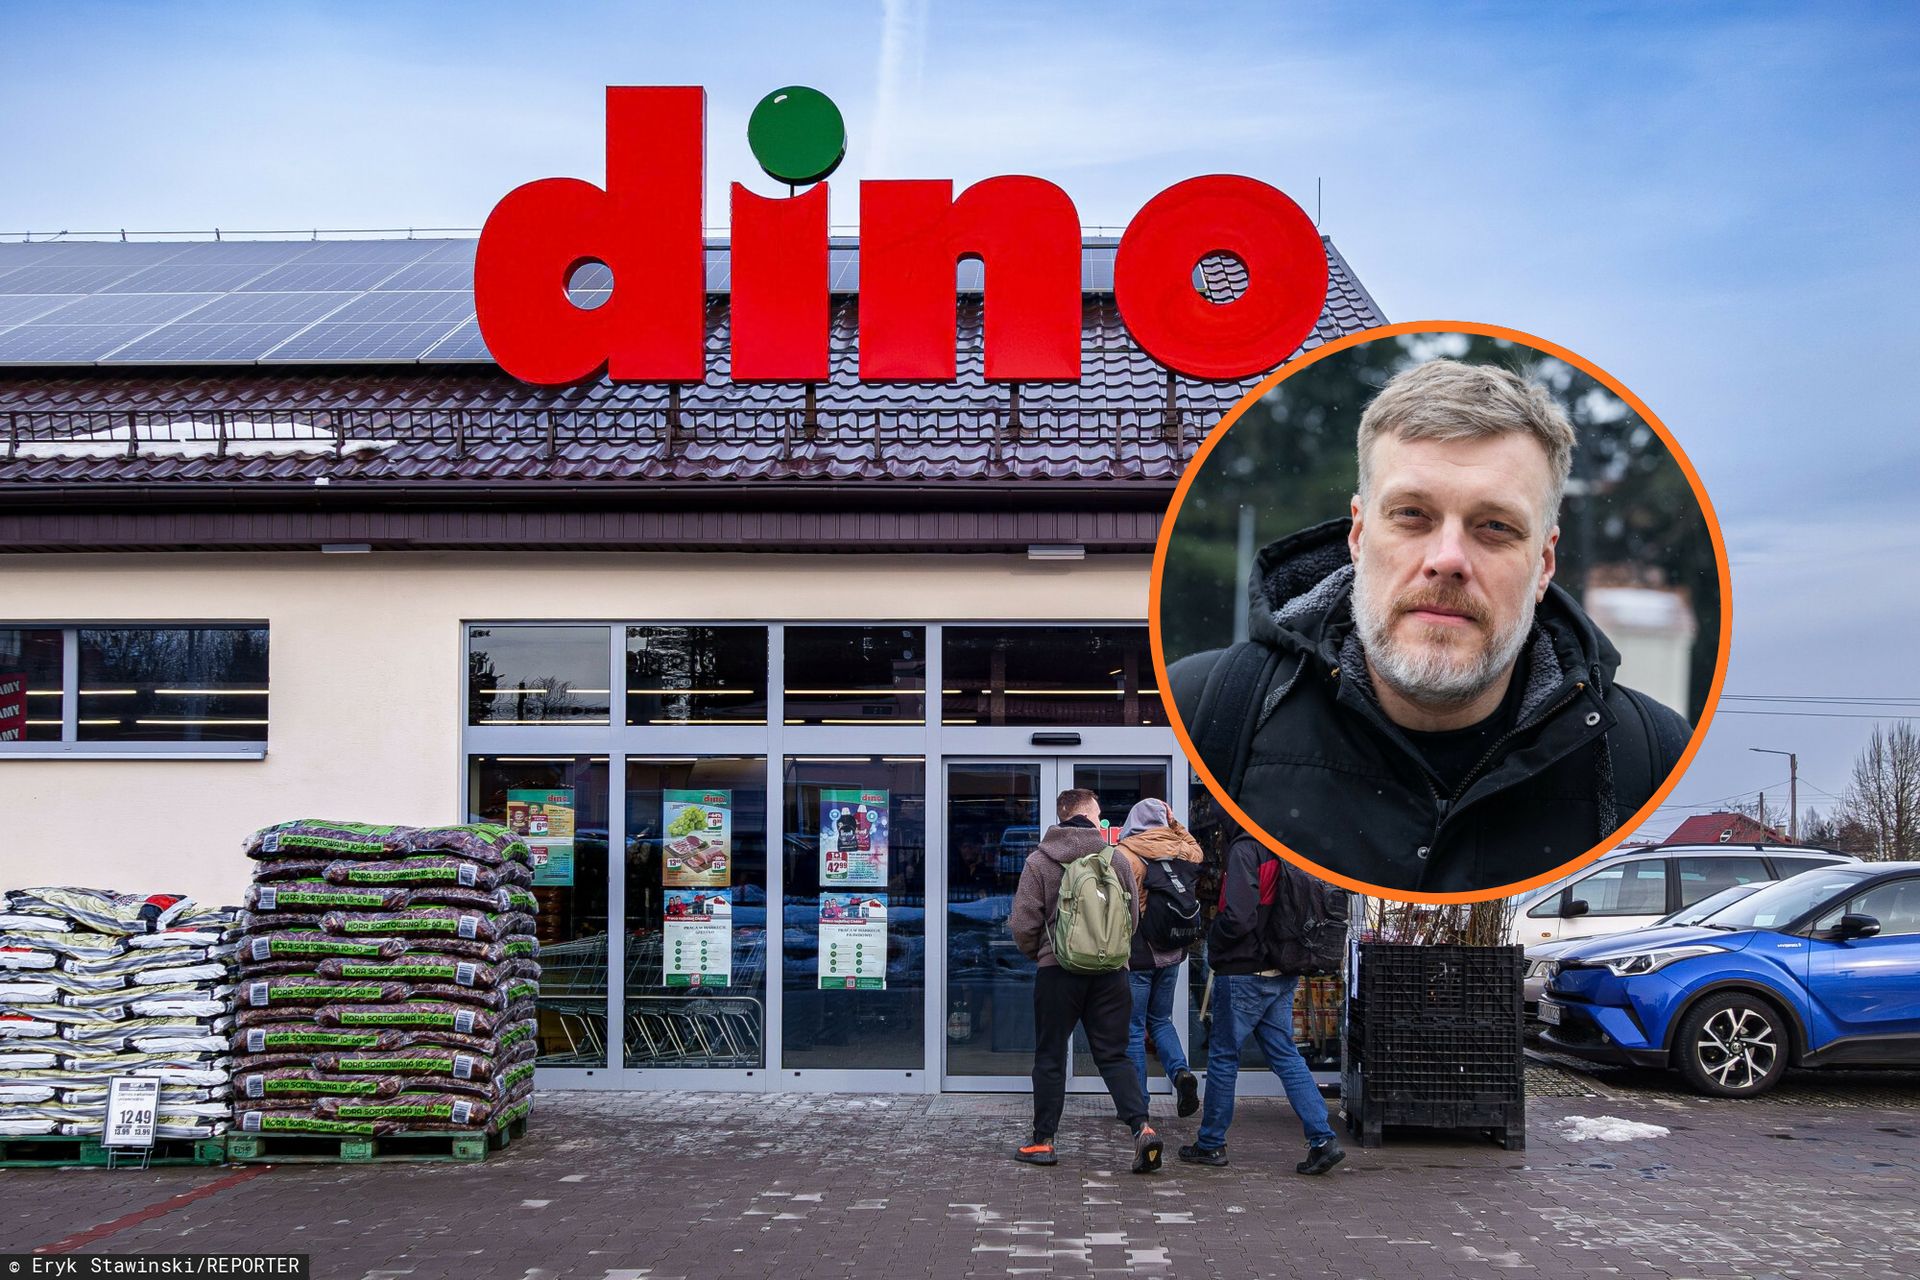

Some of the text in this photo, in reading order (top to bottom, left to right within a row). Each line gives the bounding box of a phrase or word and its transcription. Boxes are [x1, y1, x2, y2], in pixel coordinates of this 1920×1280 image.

[474, 86, 1329, 383] dino
[0, 728, 19, 741] MY
[704, 794, 725, 802] dino
[304, 837, 349, 848] SORTOWANA
[371, 921, 418, 929] SORTOWANA
[120, 1110, 151, 1124] 12.49
